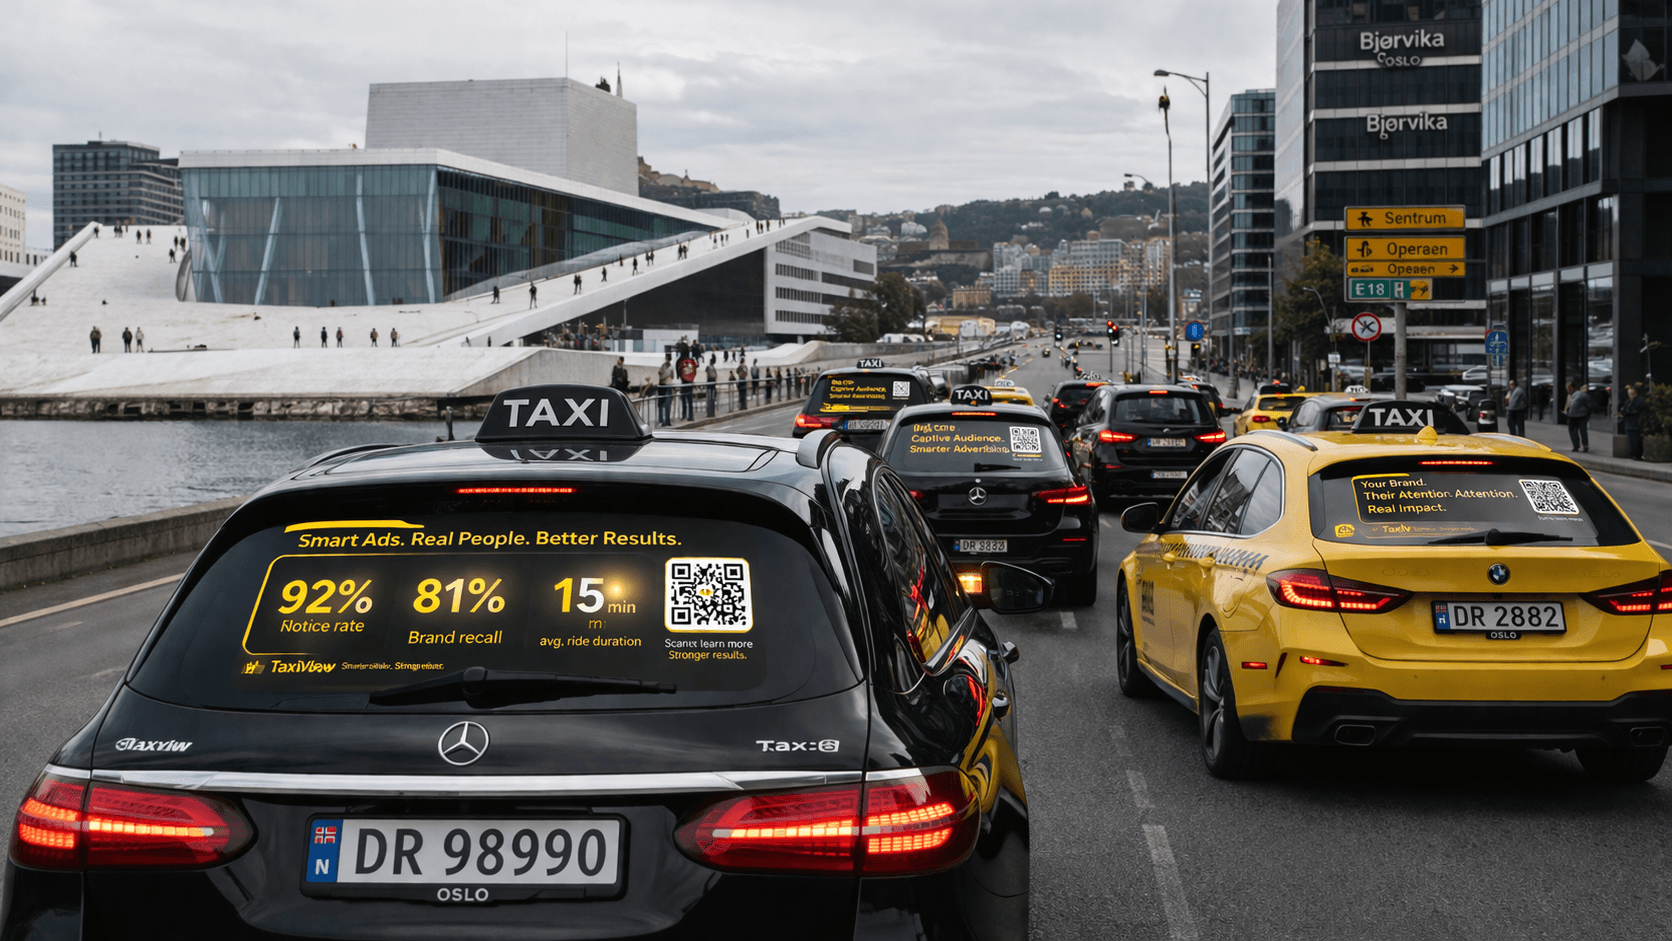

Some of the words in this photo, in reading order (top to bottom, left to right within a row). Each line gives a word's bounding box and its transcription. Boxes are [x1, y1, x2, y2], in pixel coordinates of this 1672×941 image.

[1360, 29, 1445, 53] Bjørvika
[1366, 112, 1448, 140] Bjørvika
[1384, 211, 1447, 225] Sentrum
[1386, 242, 1448, 259] Operaen
[1355, 282, 1385, 296] E18
[859, 359, 882, 368] TAXI
[956, 389, 989, 401] TAXI
[503, 398, 610, 428] TAXI
[1368, 408, 1434, 427] TAXI
[1361, 480, 1386, 489] Your
[1389, 478, 1427, 488] Brand.
[1363, 491, 1395, 501] Their
[1367, 504, 1396, 514] Real
[1399, 503, 1447, 515] Impact.
[298, 532, 359, 548] Smart
[361, 532, 405, 547] Ads.
[411, 531, 454, 546] Real
[458, 531, 530, 549] People.
[536, 531, 598, 546] Better
[603, 531, 682, 546] Results.
[277, 579, 373, 614] 92%
[412, 577, 506, 614] 81%
[554, 577, 605, 613] 15
[607, 600, 636, 613] min
[1453, 605, 1486, 627] DR
[1494, 605, 1559, 628] 2882
[280, 619, 331, 633] Notice
[333, 620, 365, 633] rate
[408, 630, 456, 644] Brand
[459, 630, 503, 644] recall
[567, 635, 590, 647] ride
[592, 635, 642, 647] duration
[1490, 631, 1517, 639] OSLO
[700, 639, 726, 648] learn
[727, 640, 754, 649] more
[668, 650, 711, 662] Stronger
[712, 651, 748, 660] results.
[354, 828, 424, 875] DR
[443, 828, 607, 876] 98990
[315, 858, 330, 875] N
[437, 887, 489, 902] OSLO
